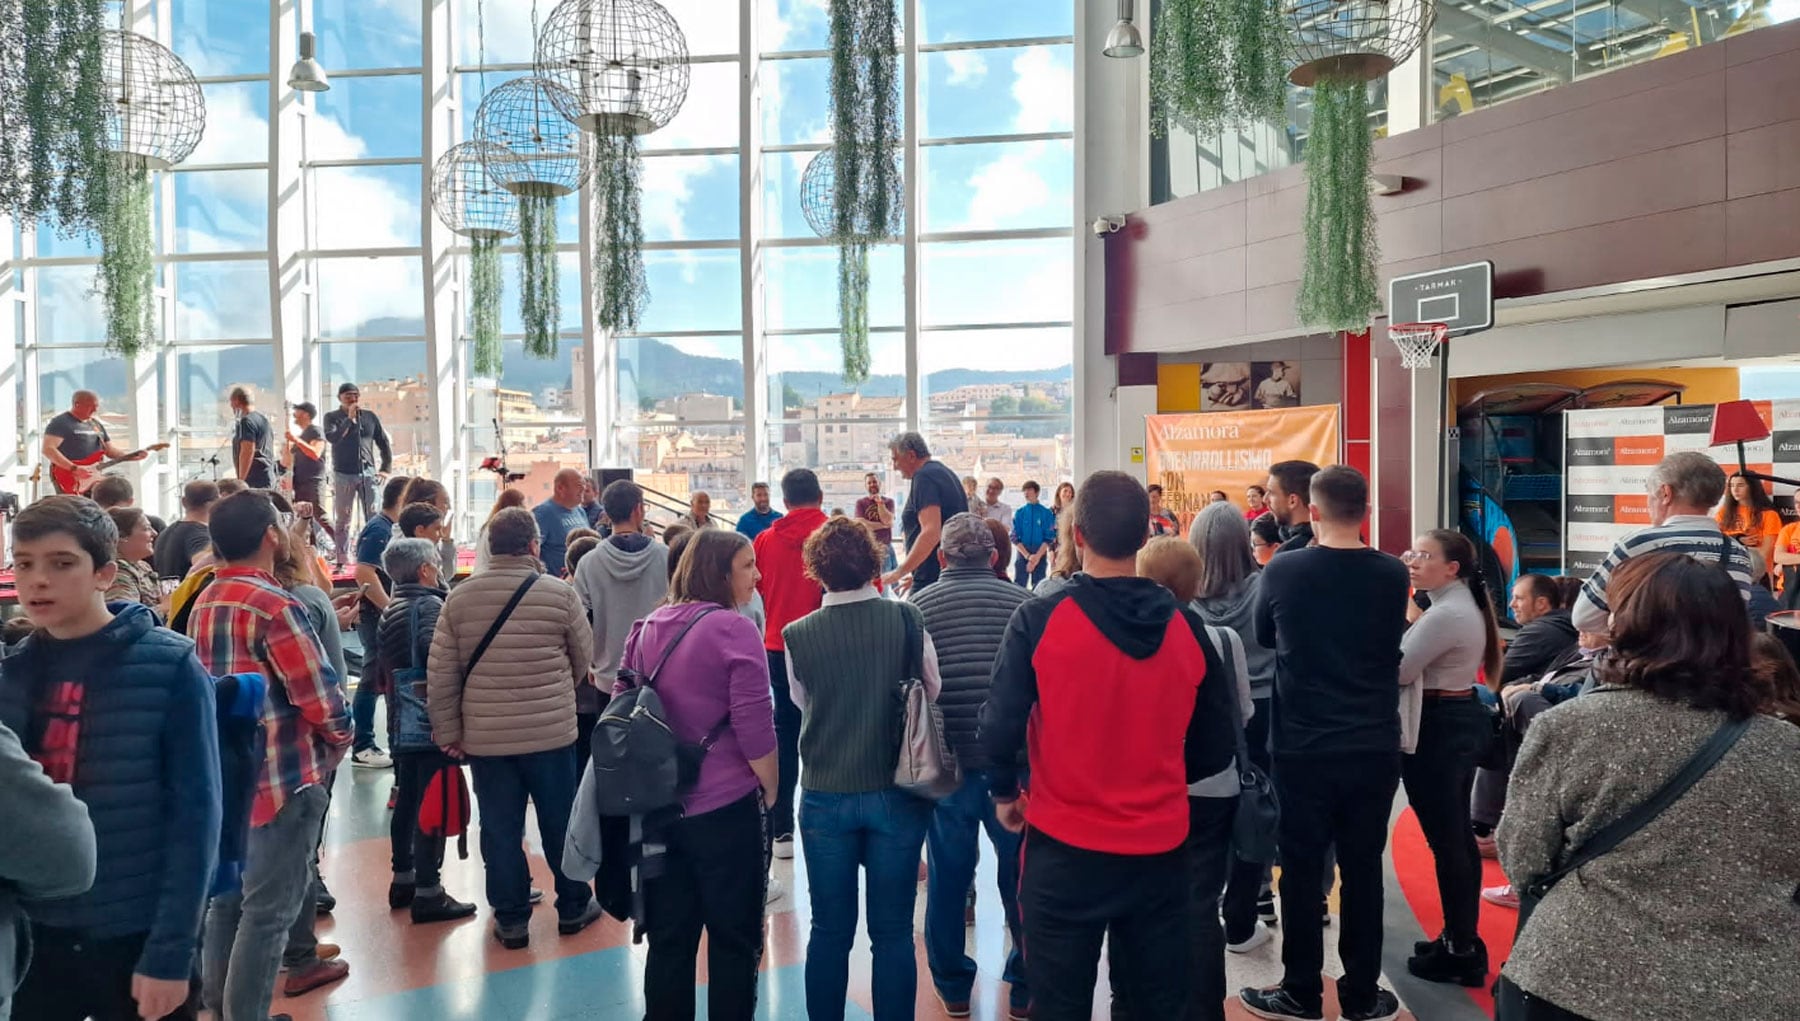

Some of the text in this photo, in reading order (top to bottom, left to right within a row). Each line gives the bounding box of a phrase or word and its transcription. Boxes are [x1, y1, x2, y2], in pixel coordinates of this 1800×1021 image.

[1420, 280, 1457, 291] TARMAK
[1668, 414, 1709, 424] Alzamora
[1160, 423, 1240, 440] Alzamora
